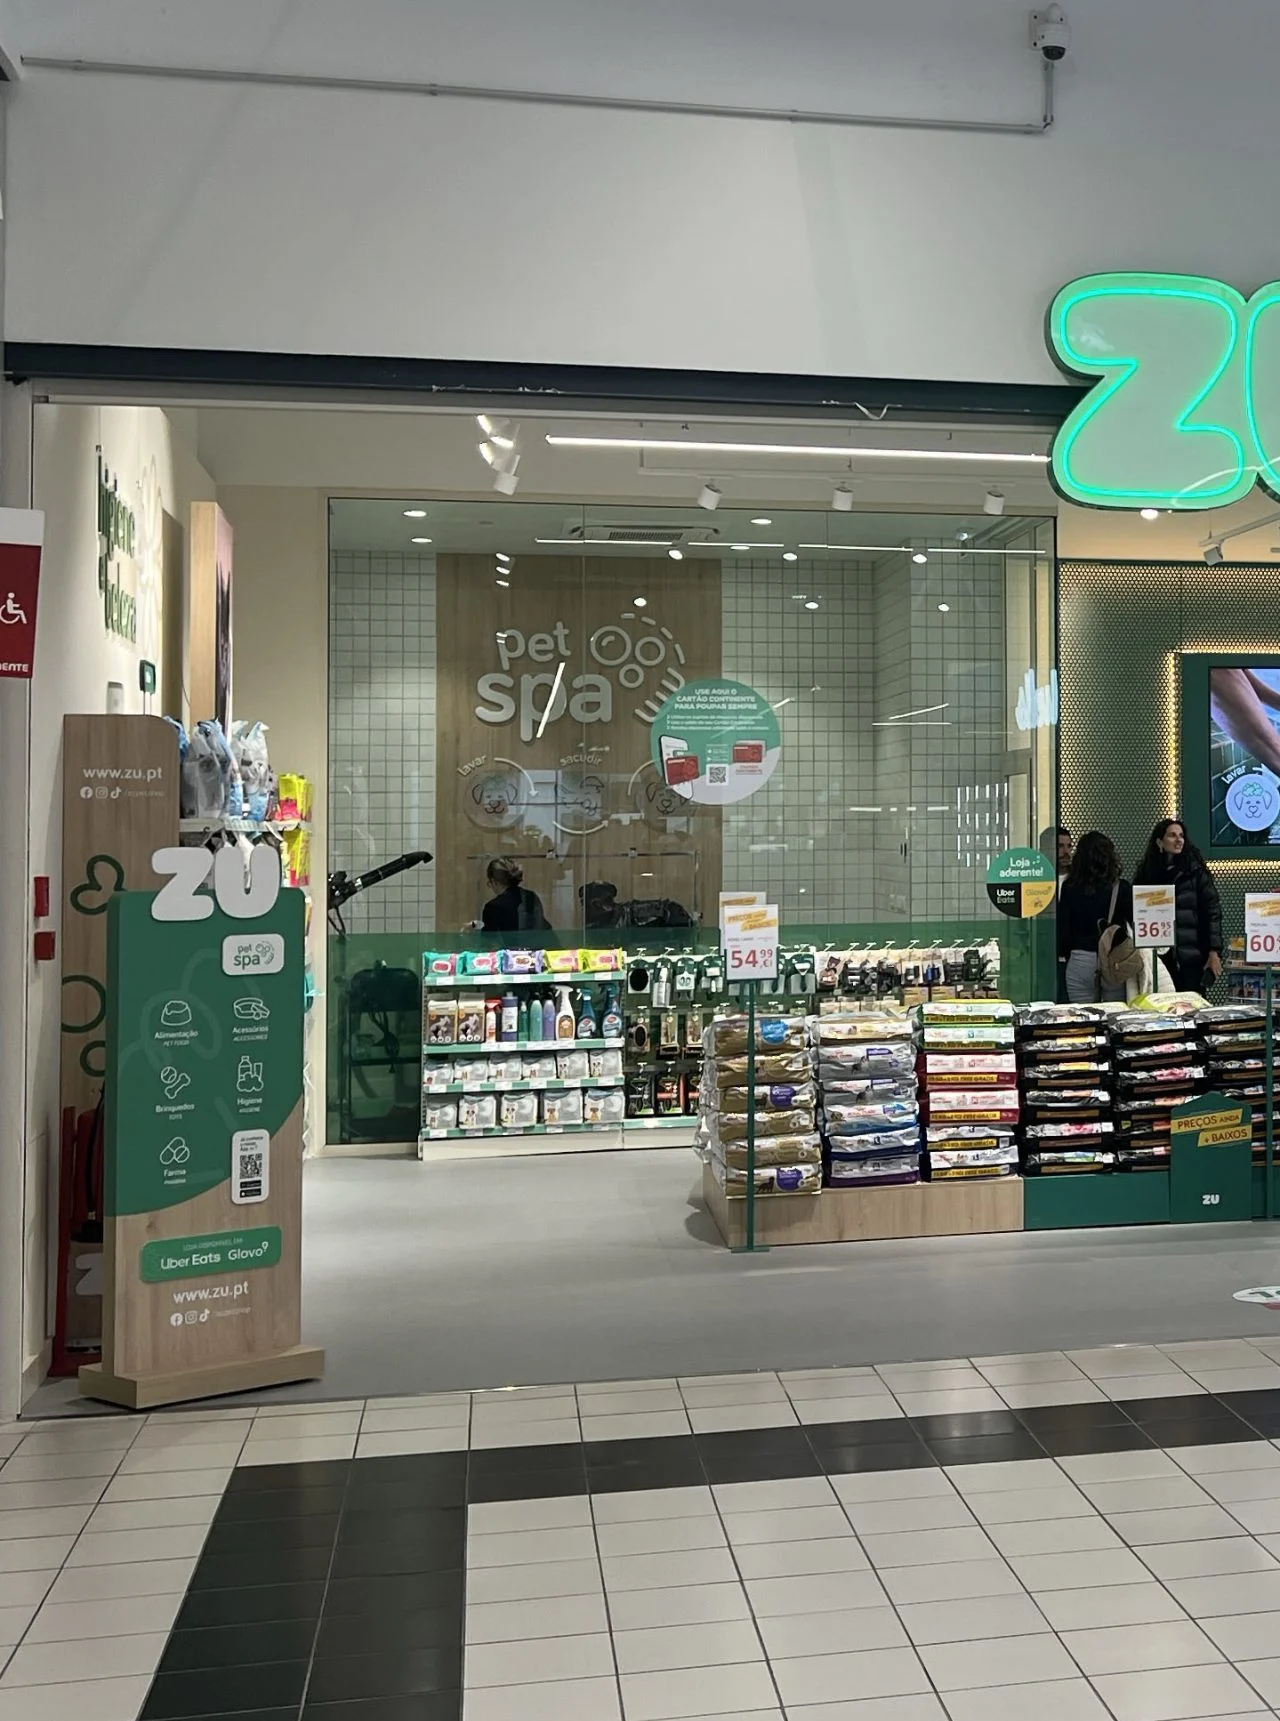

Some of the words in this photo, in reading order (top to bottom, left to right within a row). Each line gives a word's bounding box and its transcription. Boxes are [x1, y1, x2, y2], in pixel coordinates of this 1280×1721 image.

[497, 621, 571, 671] pet
[0, 662, 29, 672] ENTE
[475, 671, 613, 743] spa
[83, 767, 162, 782] www.zu.pt
[1009, 857, 1031, 868] Loja
[999, 867, 1044, 878] aderente!
[151, 846, 281, 922] ZU
[996, 888, 1015, 896] Uber
[237, 943, 252, 955] pet
[233, 954, 260, 970] spa
[154, 1030, 199, 1039] Alimentação
[1177, 1116, 1218, 1130] PREÇOS
[1211, 1129, 1248, 1142] BAIXOS
[1202, 1194, 1220, 1205] ZU
[160, 1257, 189, 1270] Uber
[192, 1253, 221, 1266] Eats
[228, 1247, 264, 1260] Glovo
[173, 1281, 249, 1304] www.zu.pt
